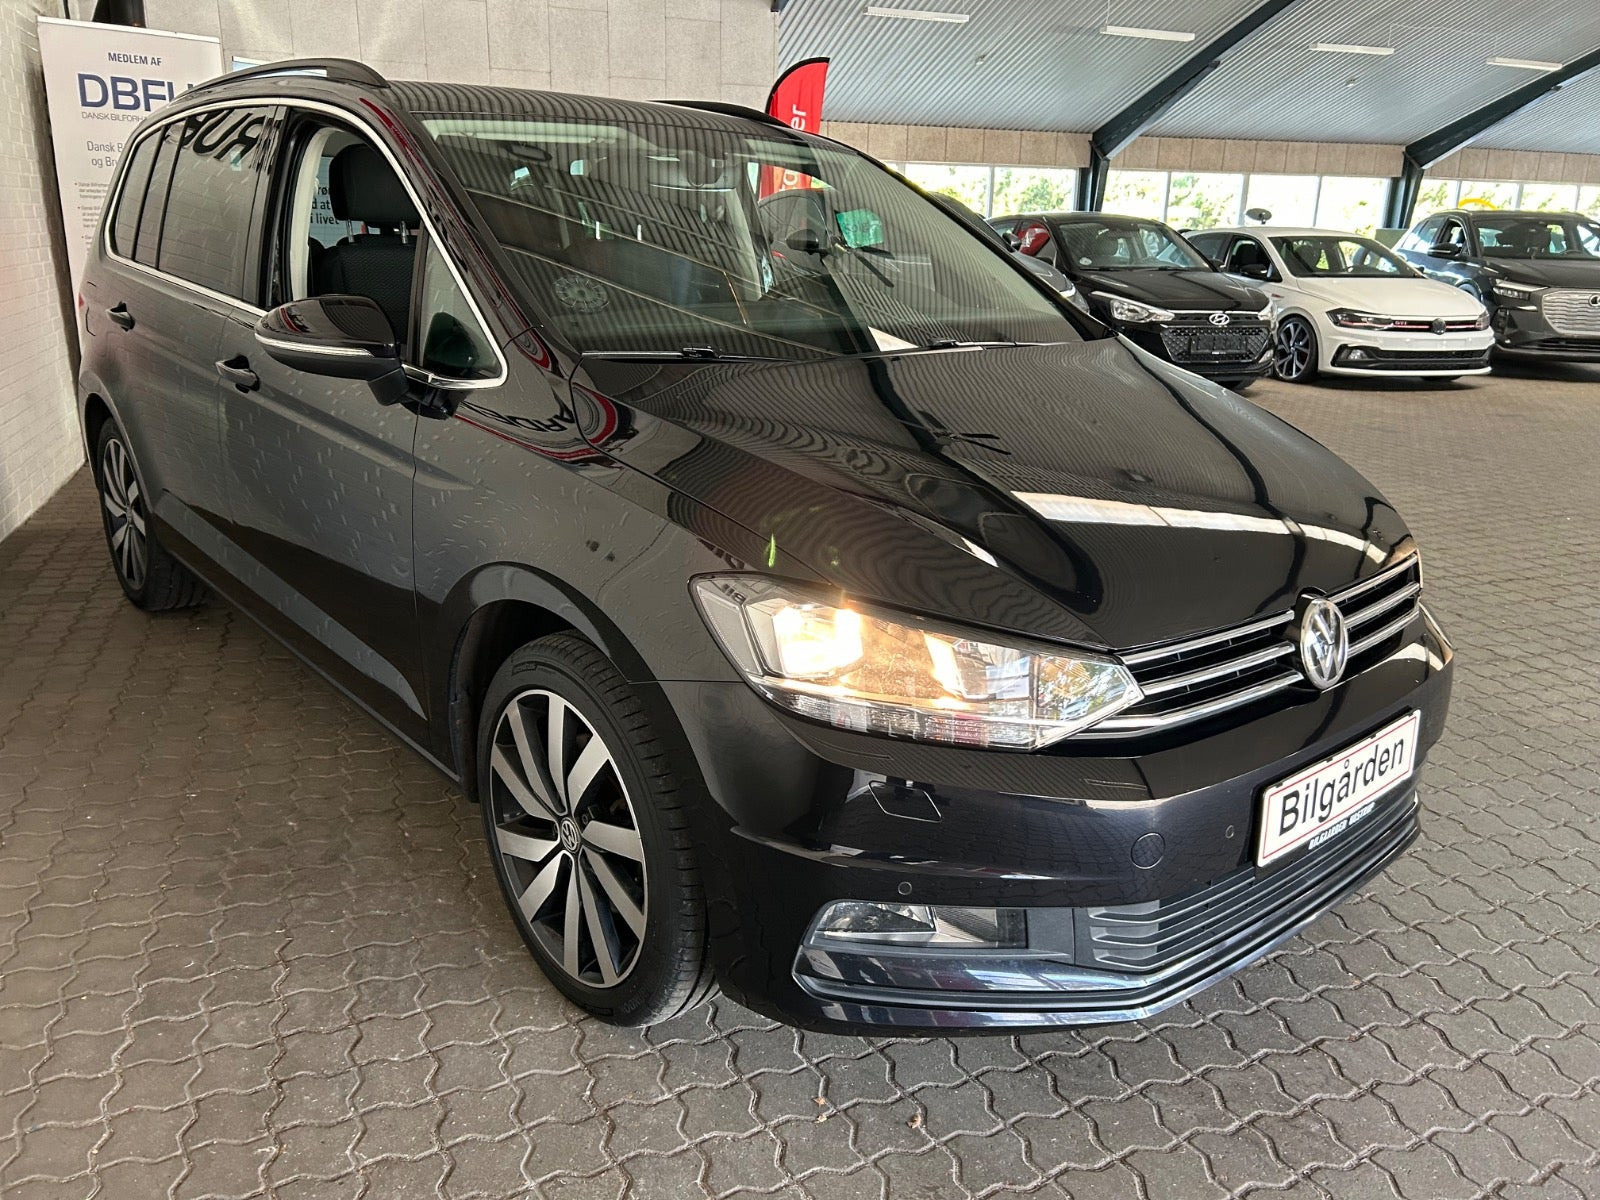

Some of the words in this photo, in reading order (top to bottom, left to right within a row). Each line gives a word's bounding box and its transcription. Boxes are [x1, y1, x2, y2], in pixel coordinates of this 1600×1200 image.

[108, 52, 148, 65] MEDLEM
[150, 57, 162, 66] AF
[81, 111, 110, 120] DANSK
[110, 113, 147, 122] BILFORH
[86, 140, 115, 152] Dansk
[91, 158, 103, 169] og
[320, 199, 331, 210] at
[1278, 738, 1404, 837] Bilgården
